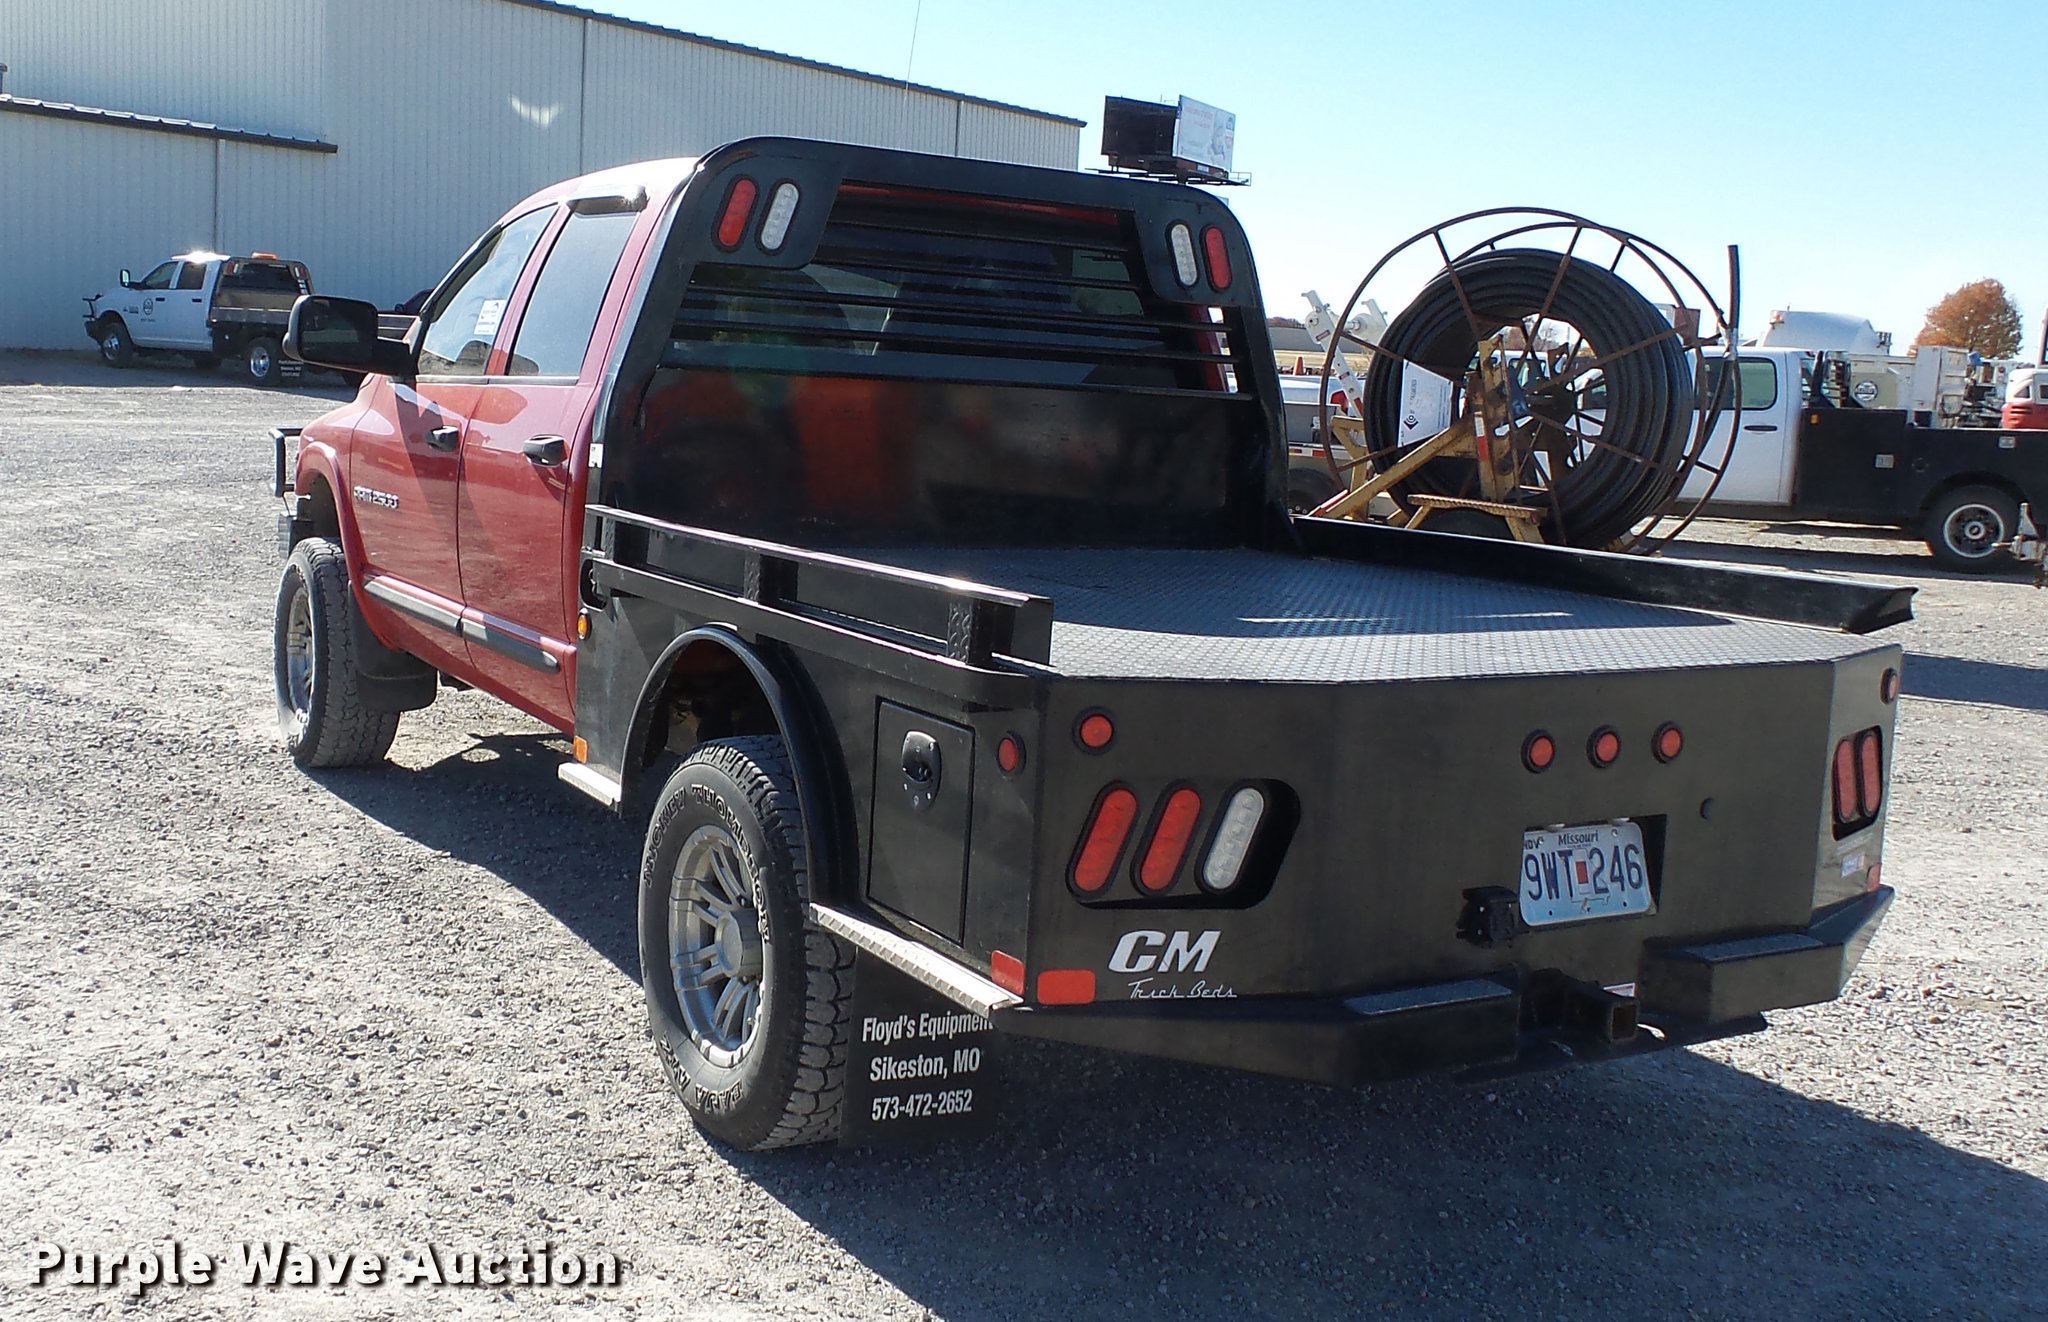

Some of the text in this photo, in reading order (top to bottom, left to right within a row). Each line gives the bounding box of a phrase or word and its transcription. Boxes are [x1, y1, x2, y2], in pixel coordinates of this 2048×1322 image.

[1558, 829, 1599, 846] Missouri
[1524, 843, 1643, 901] 9WT 246
[1108, 930, 1222, 973] CM
[1187, 980, 1238, 998] Beds
[862, 1014, 915, 1045] Floyd's
[869, 1047, 981, 1082] Sikeston, MO
[871, 1088, 973, 1121] 573-472-2652
